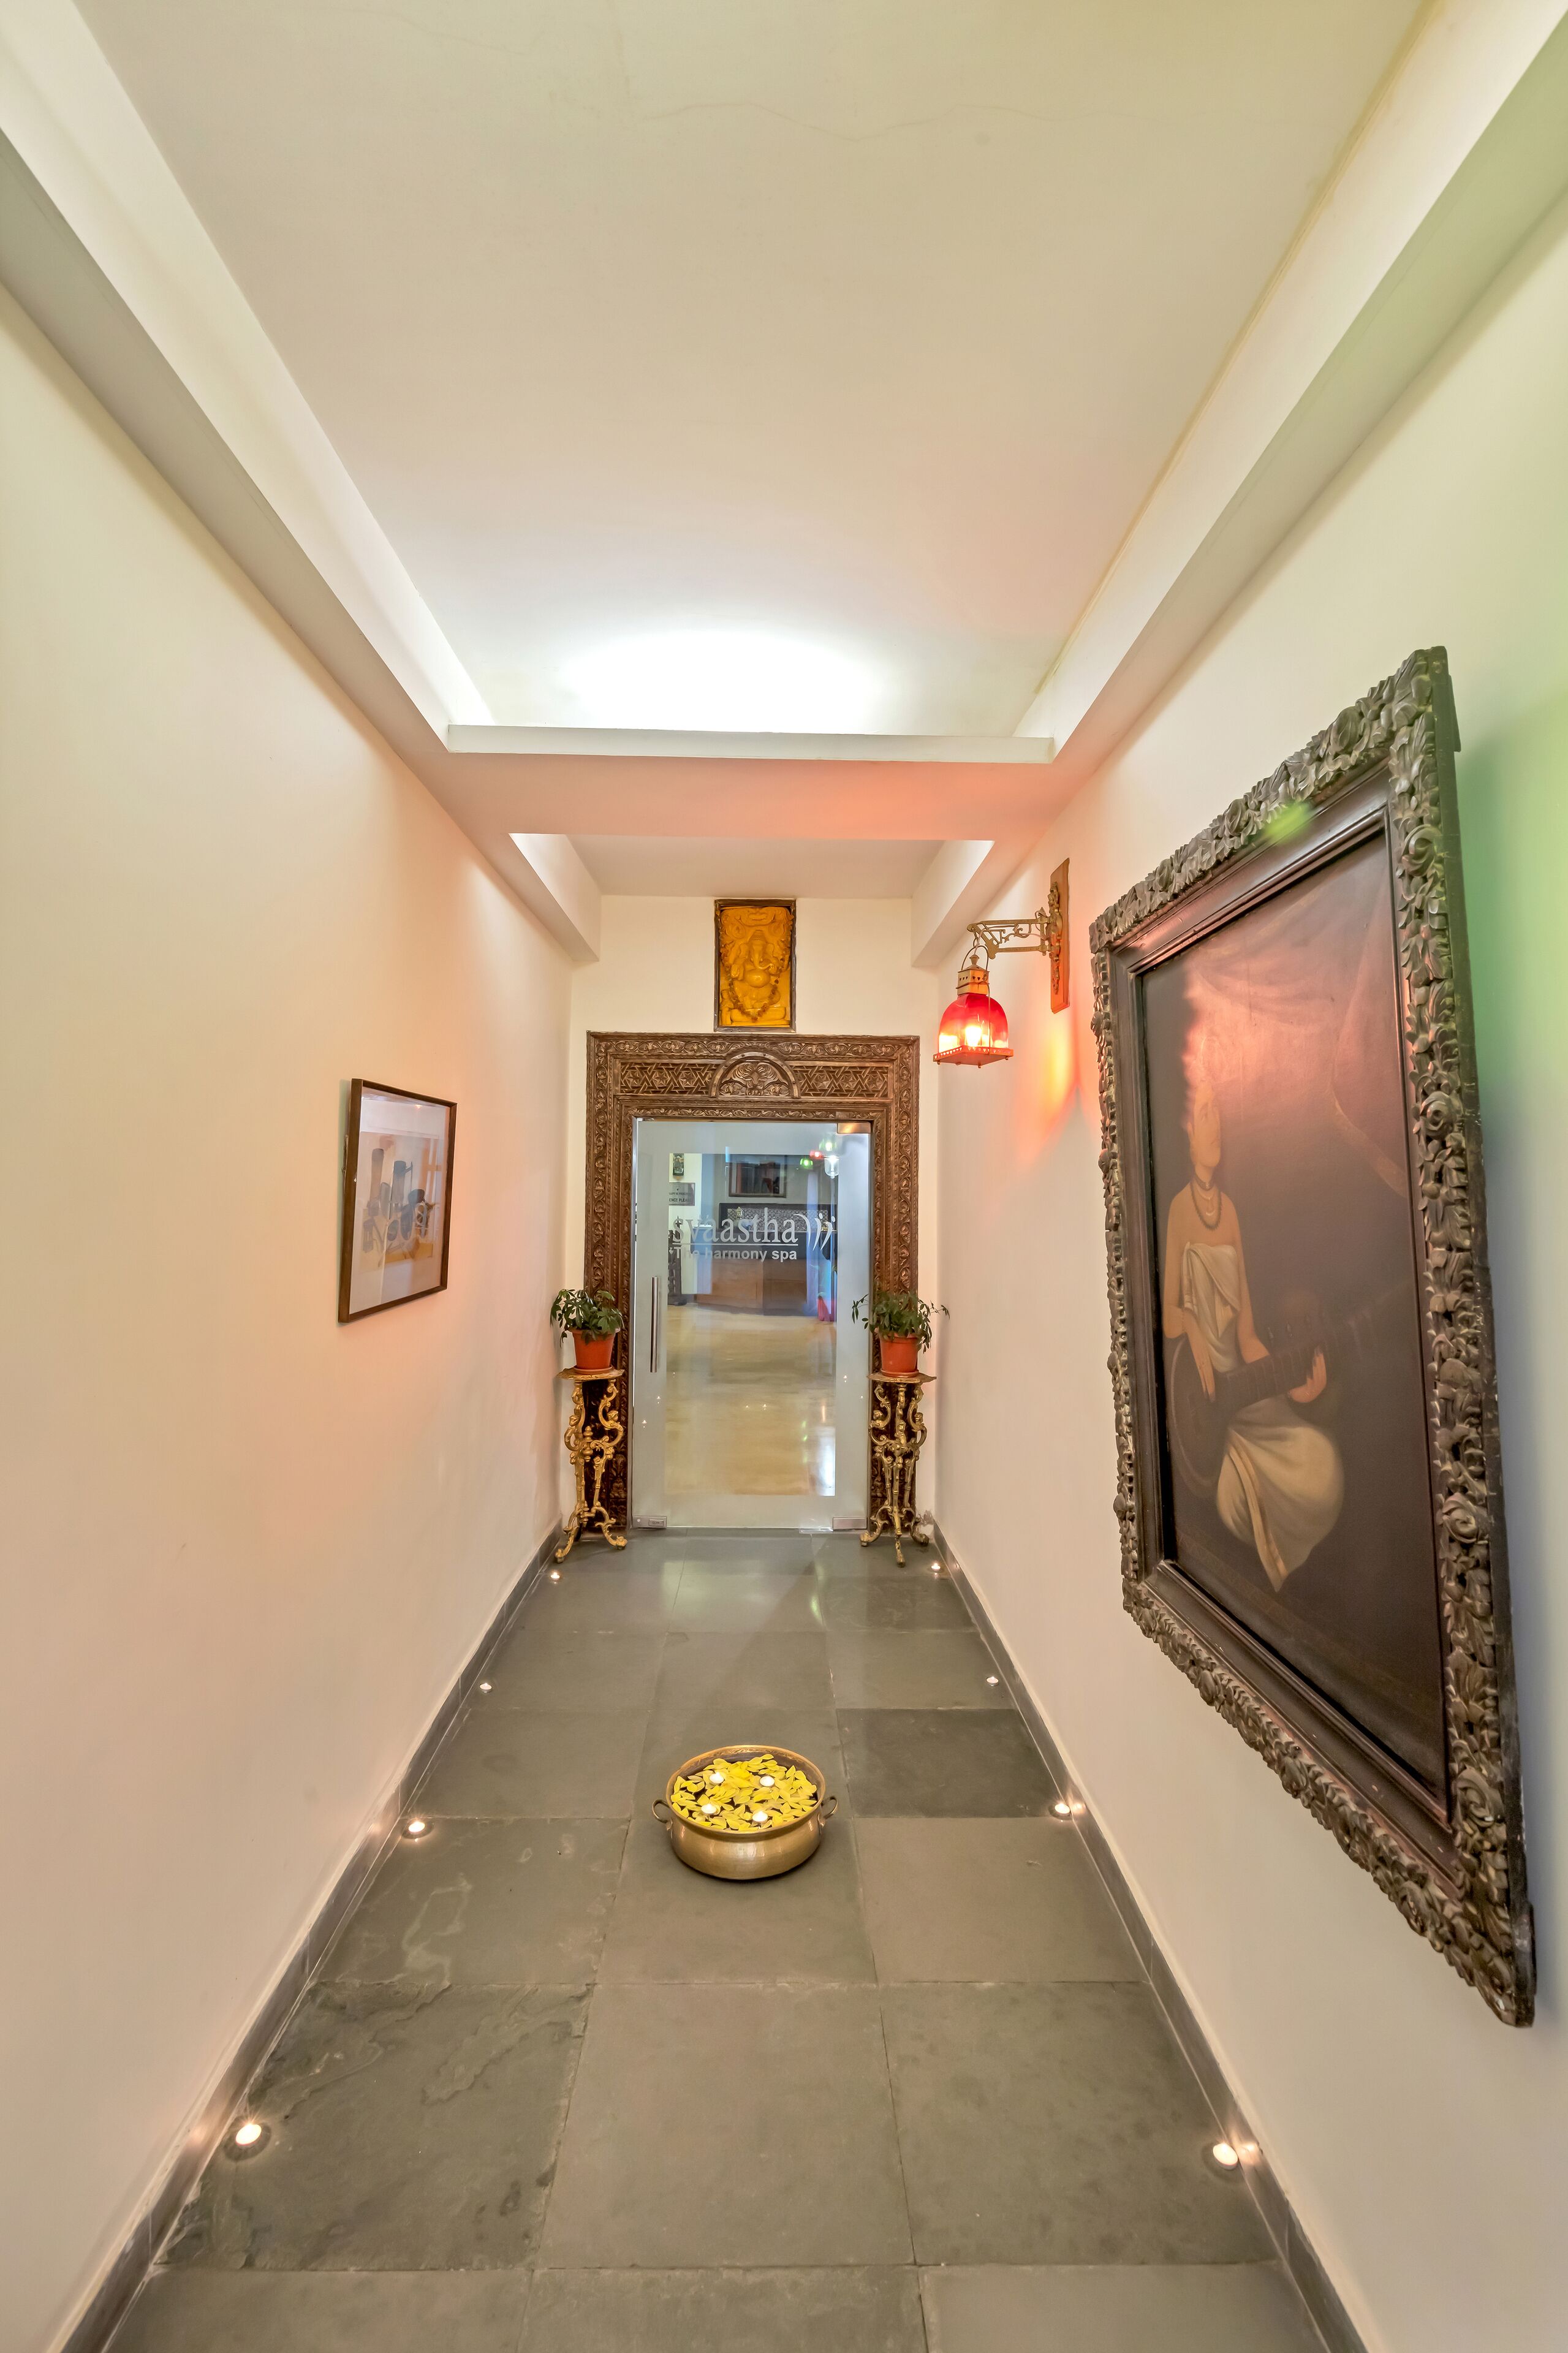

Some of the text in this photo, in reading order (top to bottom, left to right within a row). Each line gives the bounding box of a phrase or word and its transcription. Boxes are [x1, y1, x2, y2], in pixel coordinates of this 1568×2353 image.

[672, 1207, 798, 1243] svaastha
[705, 1246, 767, 1262] harmony
[771, 1250, 797, 1263] spa
